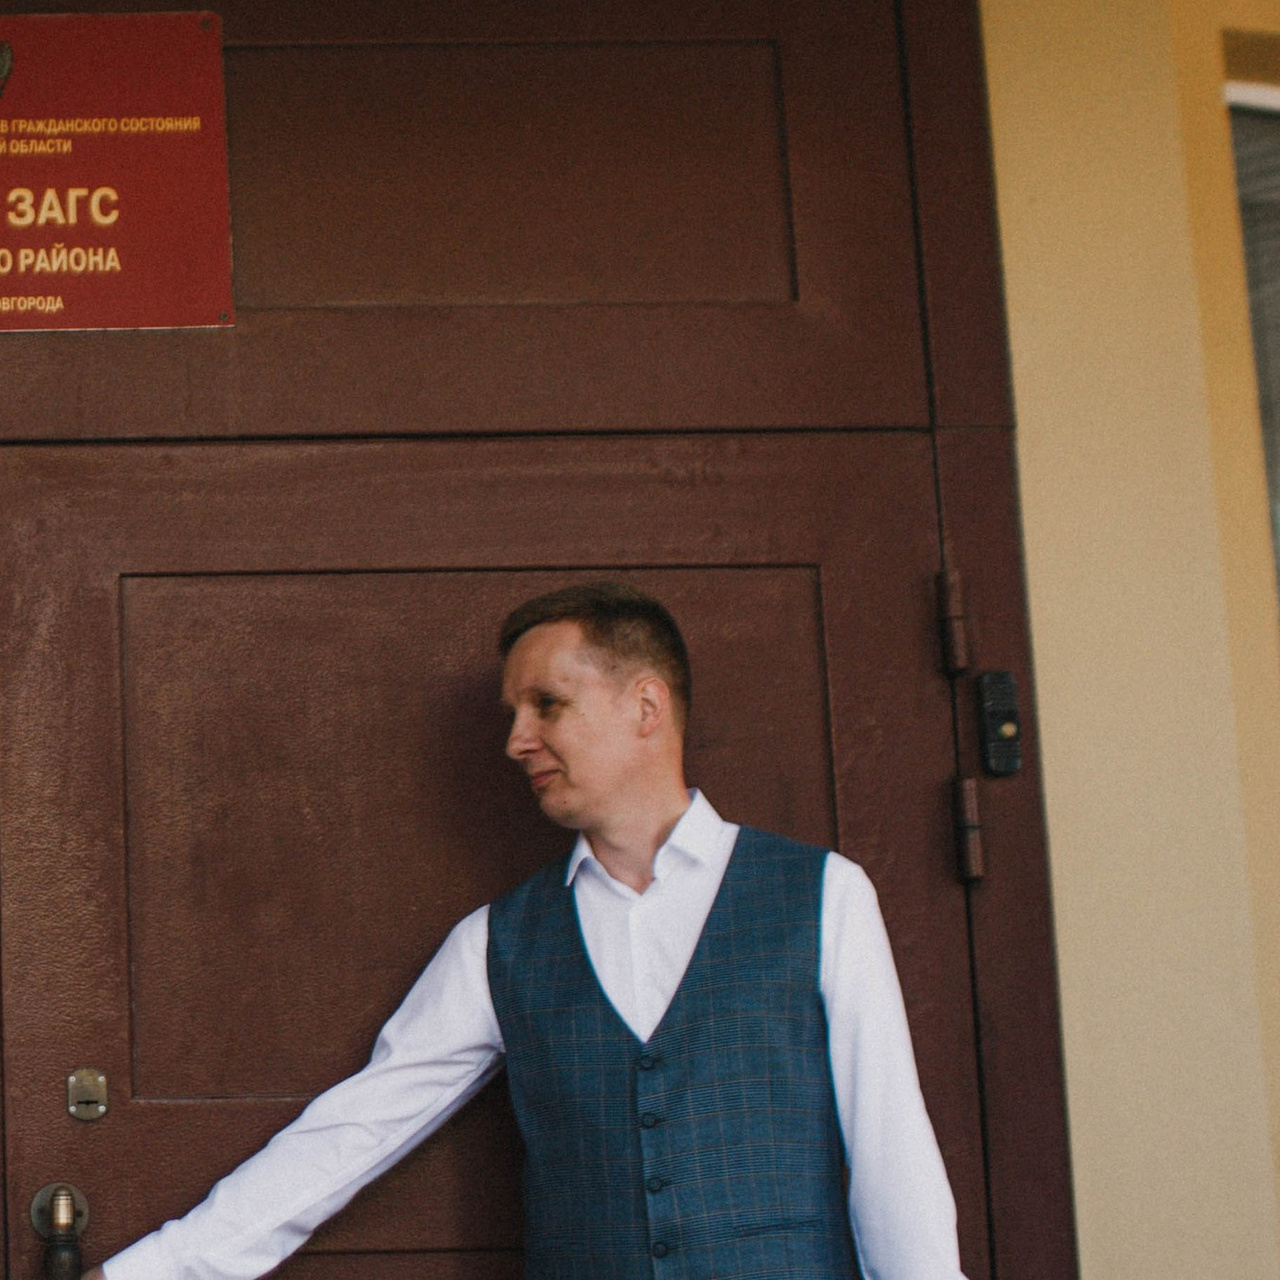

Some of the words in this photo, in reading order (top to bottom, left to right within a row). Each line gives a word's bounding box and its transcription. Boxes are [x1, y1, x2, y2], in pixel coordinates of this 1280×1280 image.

[11, 119, 118, 135] ГРАЖДАНСКОГО
[121, 117, 200, 132] СОСТОЯНИЯ
[10, 139, 71, 154] ОБЛАСТИ
[8, 187, 118, 227] ЗАГС
[19, 243, 121, 273] РАЙОНА
